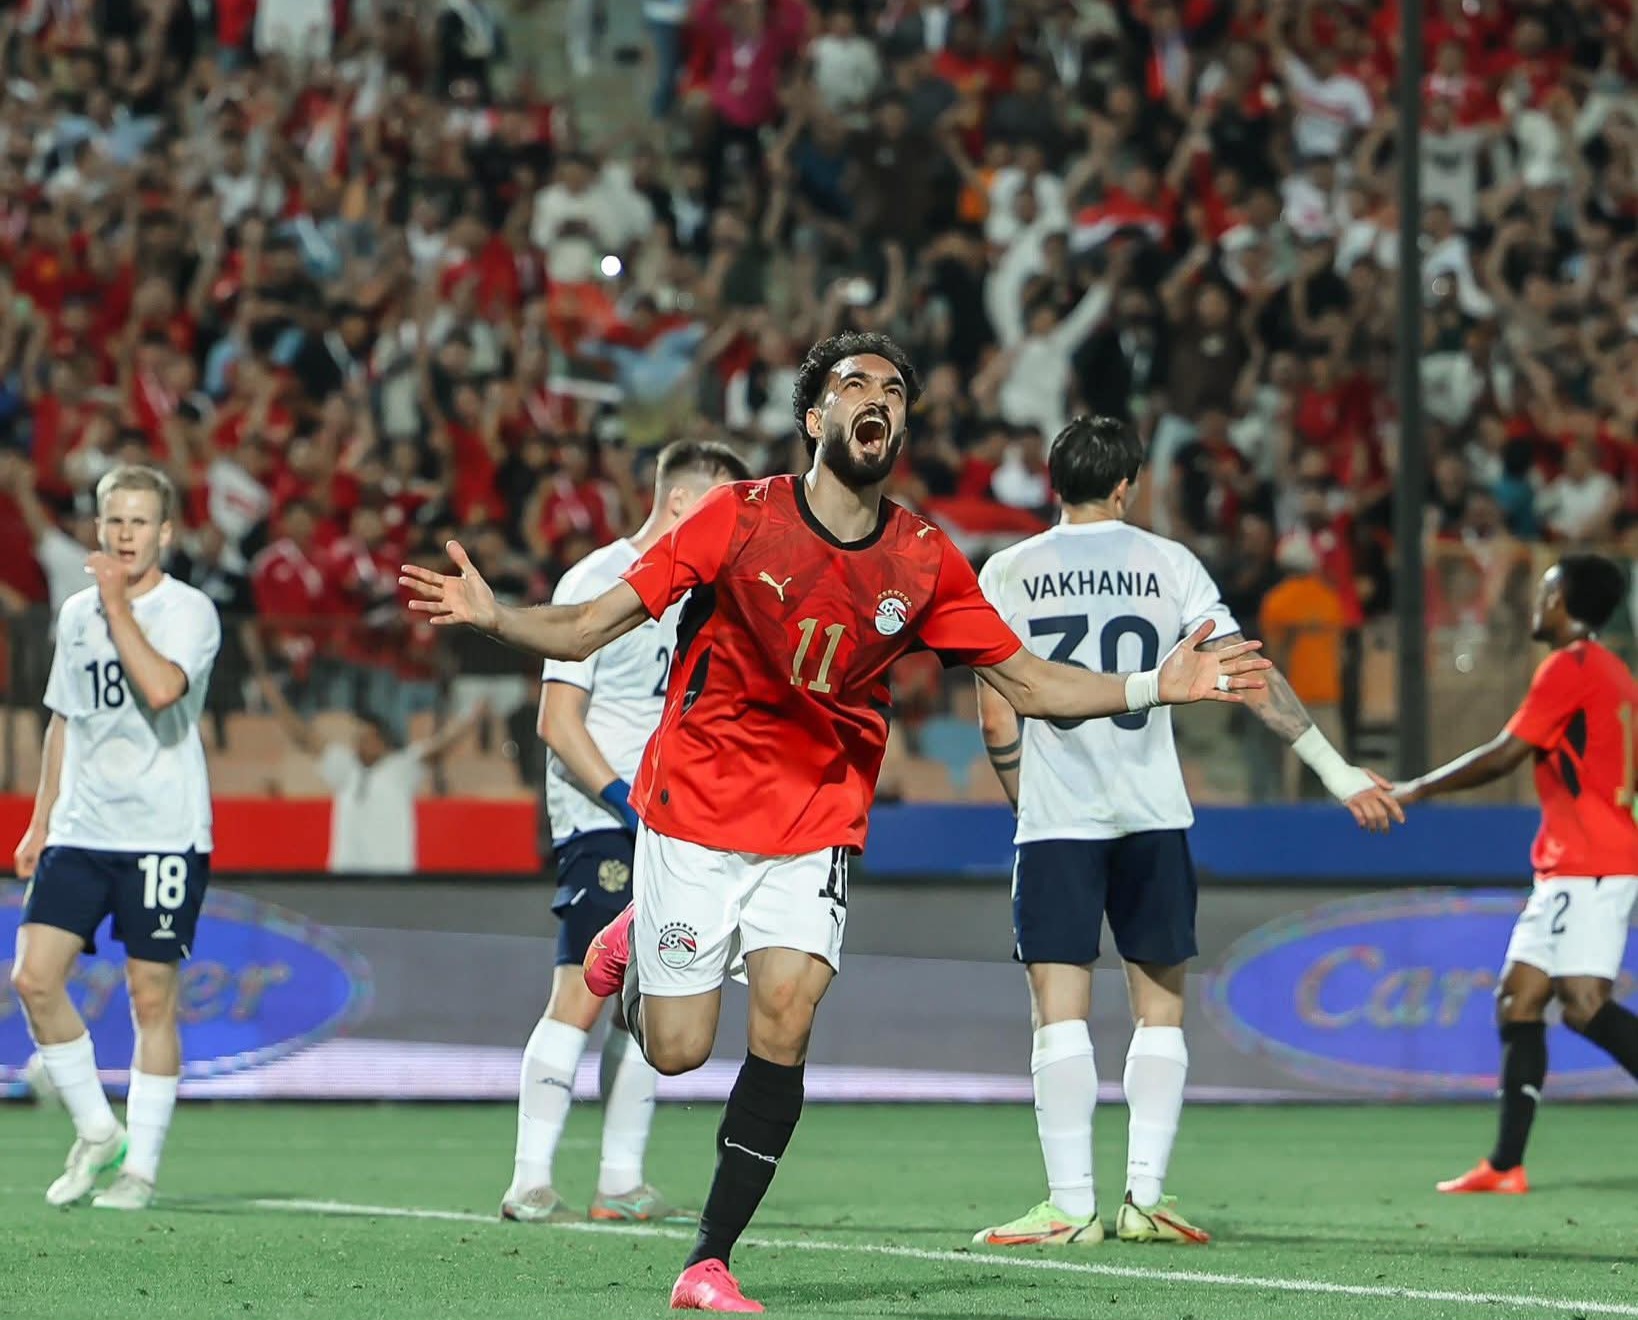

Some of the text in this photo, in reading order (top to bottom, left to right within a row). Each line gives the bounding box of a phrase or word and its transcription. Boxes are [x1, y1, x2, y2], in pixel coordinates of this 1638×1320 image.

[1023, 569, 1161, 601] VAKHANIA
[790, 617, 847, 694] 11
[85, 660, 126, 709] 18
[137, 854, 188, 910] 18
[1550, 891, 1570, 934] 2
